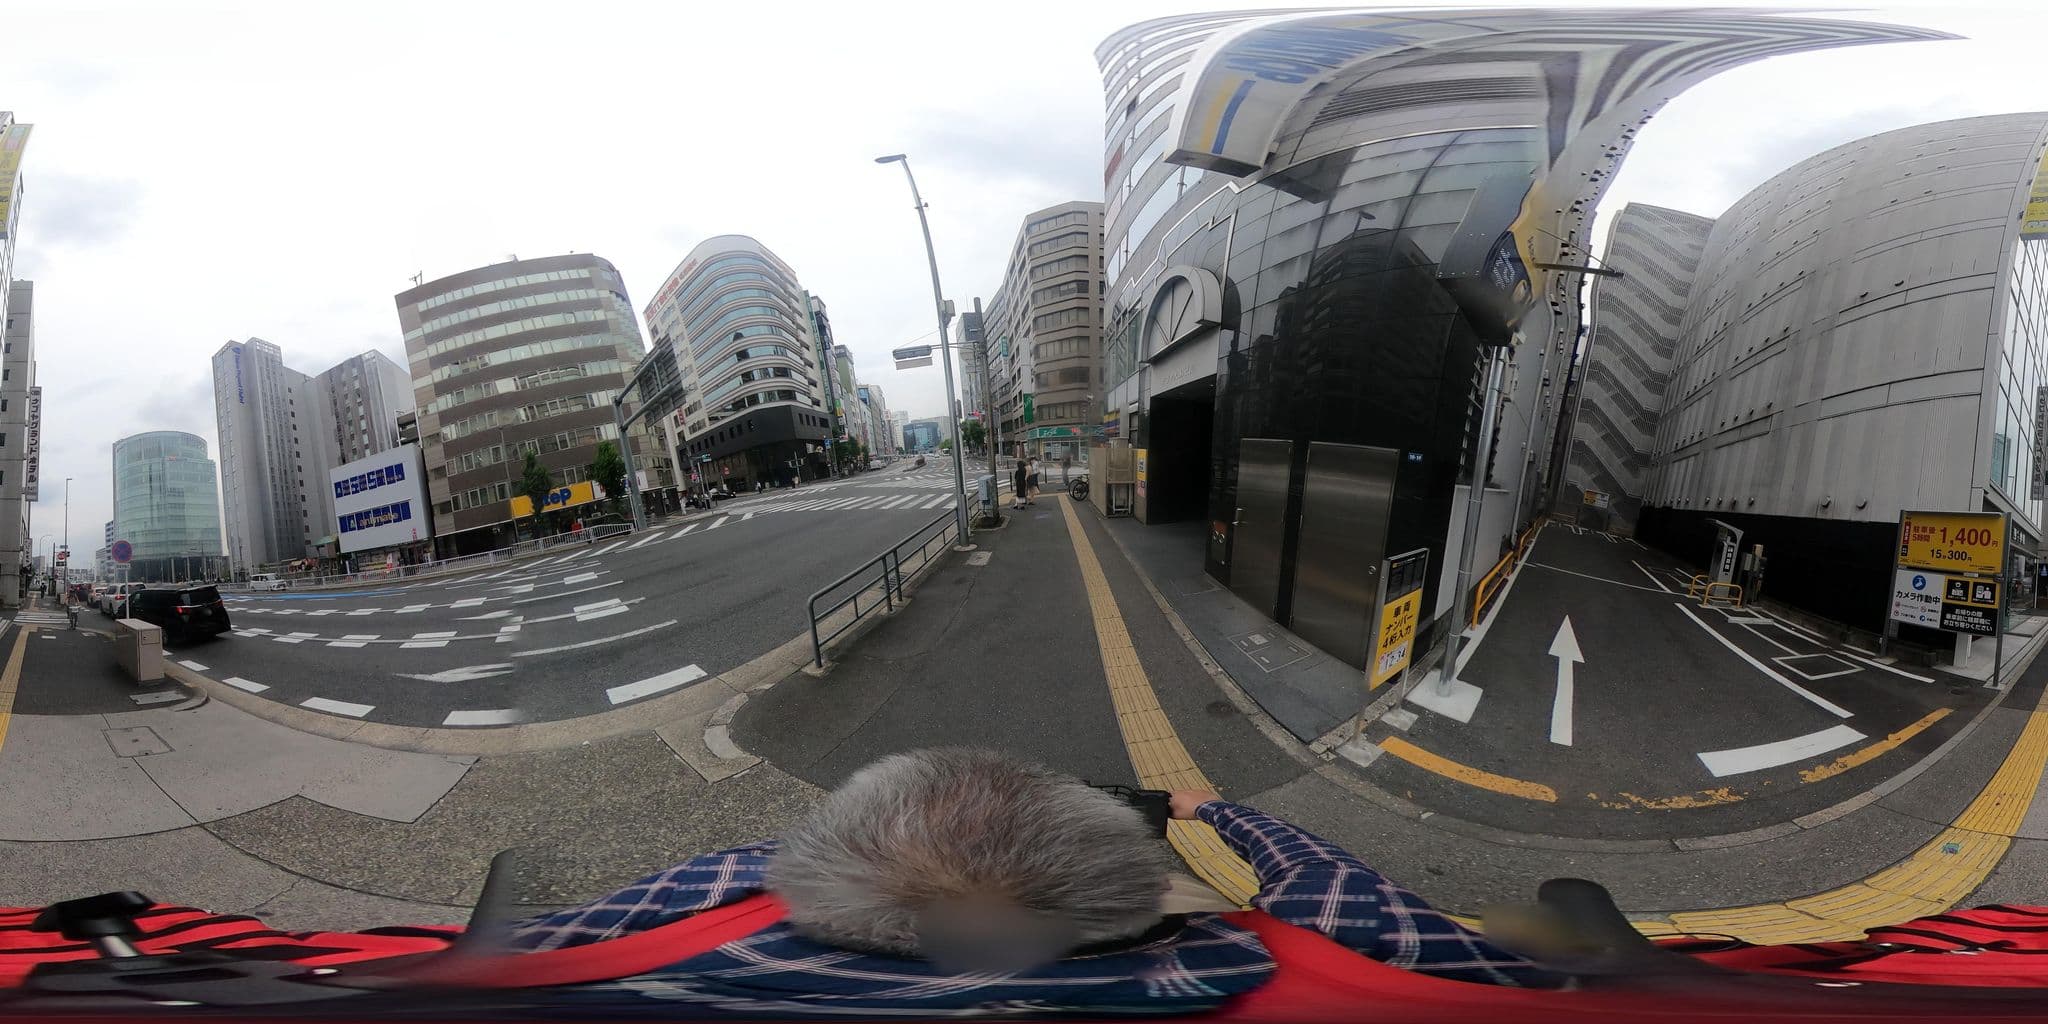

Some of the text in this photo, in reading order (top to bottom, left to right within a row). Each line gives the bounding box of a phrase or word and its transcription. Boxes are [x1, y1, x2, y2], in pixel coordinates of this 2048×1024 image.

[1896, 590, 1940, 605] カメラ作動中
[1393, 600, 1411, 617] 車両
[1386, 614, 1413, 636] ナンバー
[1943, 619, 1993, 632] お立ち寄りください
[1383, 624, 1412, 648] 4桁入力
